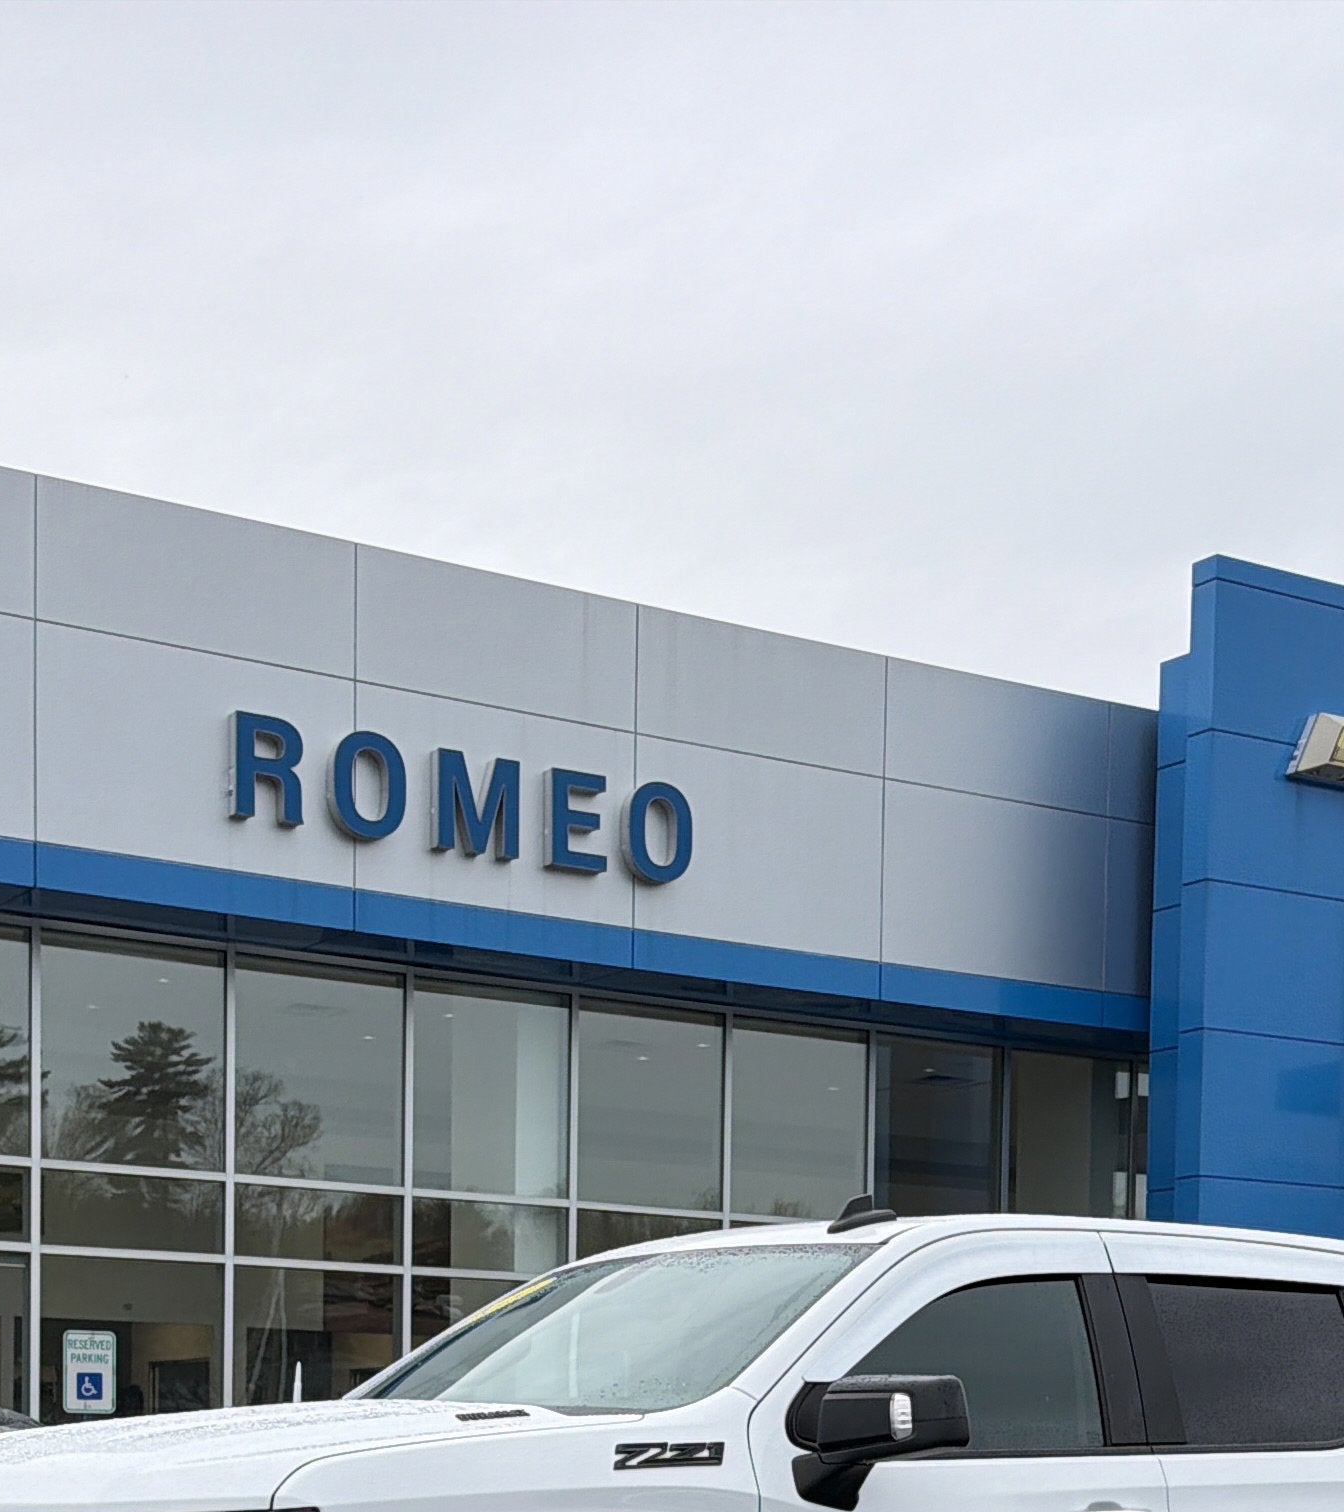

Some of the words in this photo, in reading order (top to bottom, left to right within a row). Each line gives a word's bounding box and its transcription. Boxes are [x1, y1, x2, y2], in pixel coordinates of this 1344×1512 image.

[227, 709, 694, 886] ROMEO
[67, 1339, 112, 1351] RESERVED
[70, 1353, 110, 1364] PARKING
[613, 1441, 725, 1471] Z71
